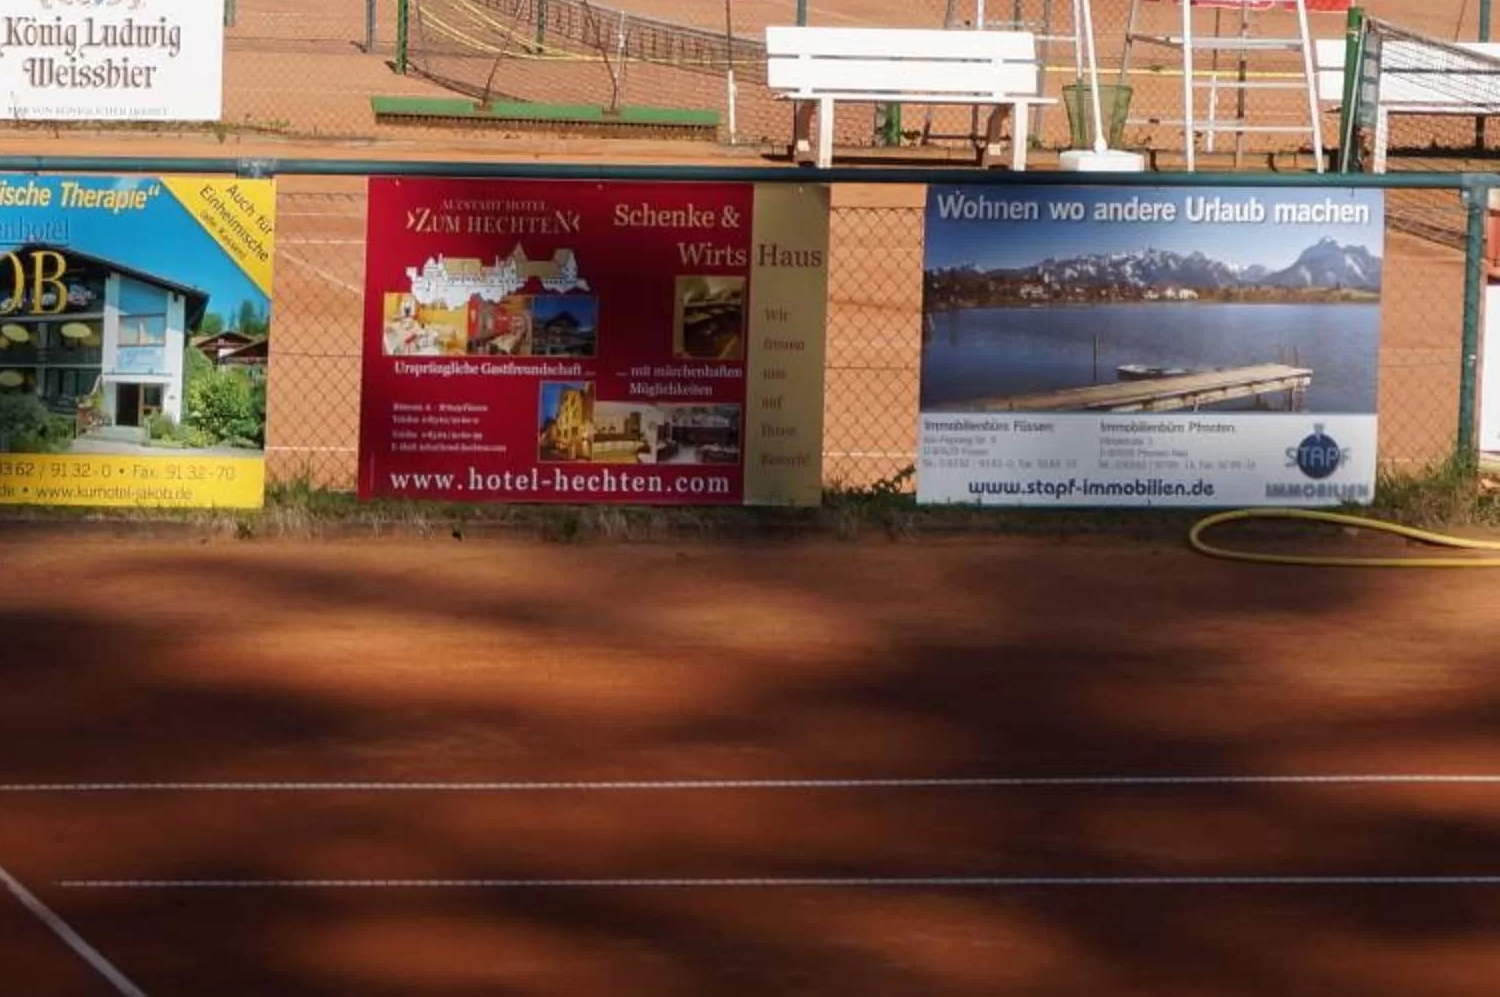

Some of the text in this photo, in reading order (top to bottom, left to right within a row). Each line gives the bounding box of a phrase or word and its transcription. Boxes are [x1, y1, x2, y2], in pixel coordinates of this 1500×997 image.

[78, 16, 182, 58] Ludwig
[22, 56, 157, 89] Weissbier
[225, 184, 255, 218] Auch
[937, 193, 1370, 224] Wohnen wo andere Urlaub machen
[199, 184, 269, 263] Einheimische
[613, 202, 741, 229] Schenke &
[677, 242, 823, 267] Wirts Haus
[394, 360, 582, 378] Ursprüngliche Gastfreundschaft
[629, 364, 652, 378] mit
[629, 382, 714, 398] Möglichkeiten
[1284, 445, 1351, 469] STAPF
[390, 466, 730, 493] www.hotel-hechten.com
[969, 477, 1215, 500] www.stapf-immobilien.de
